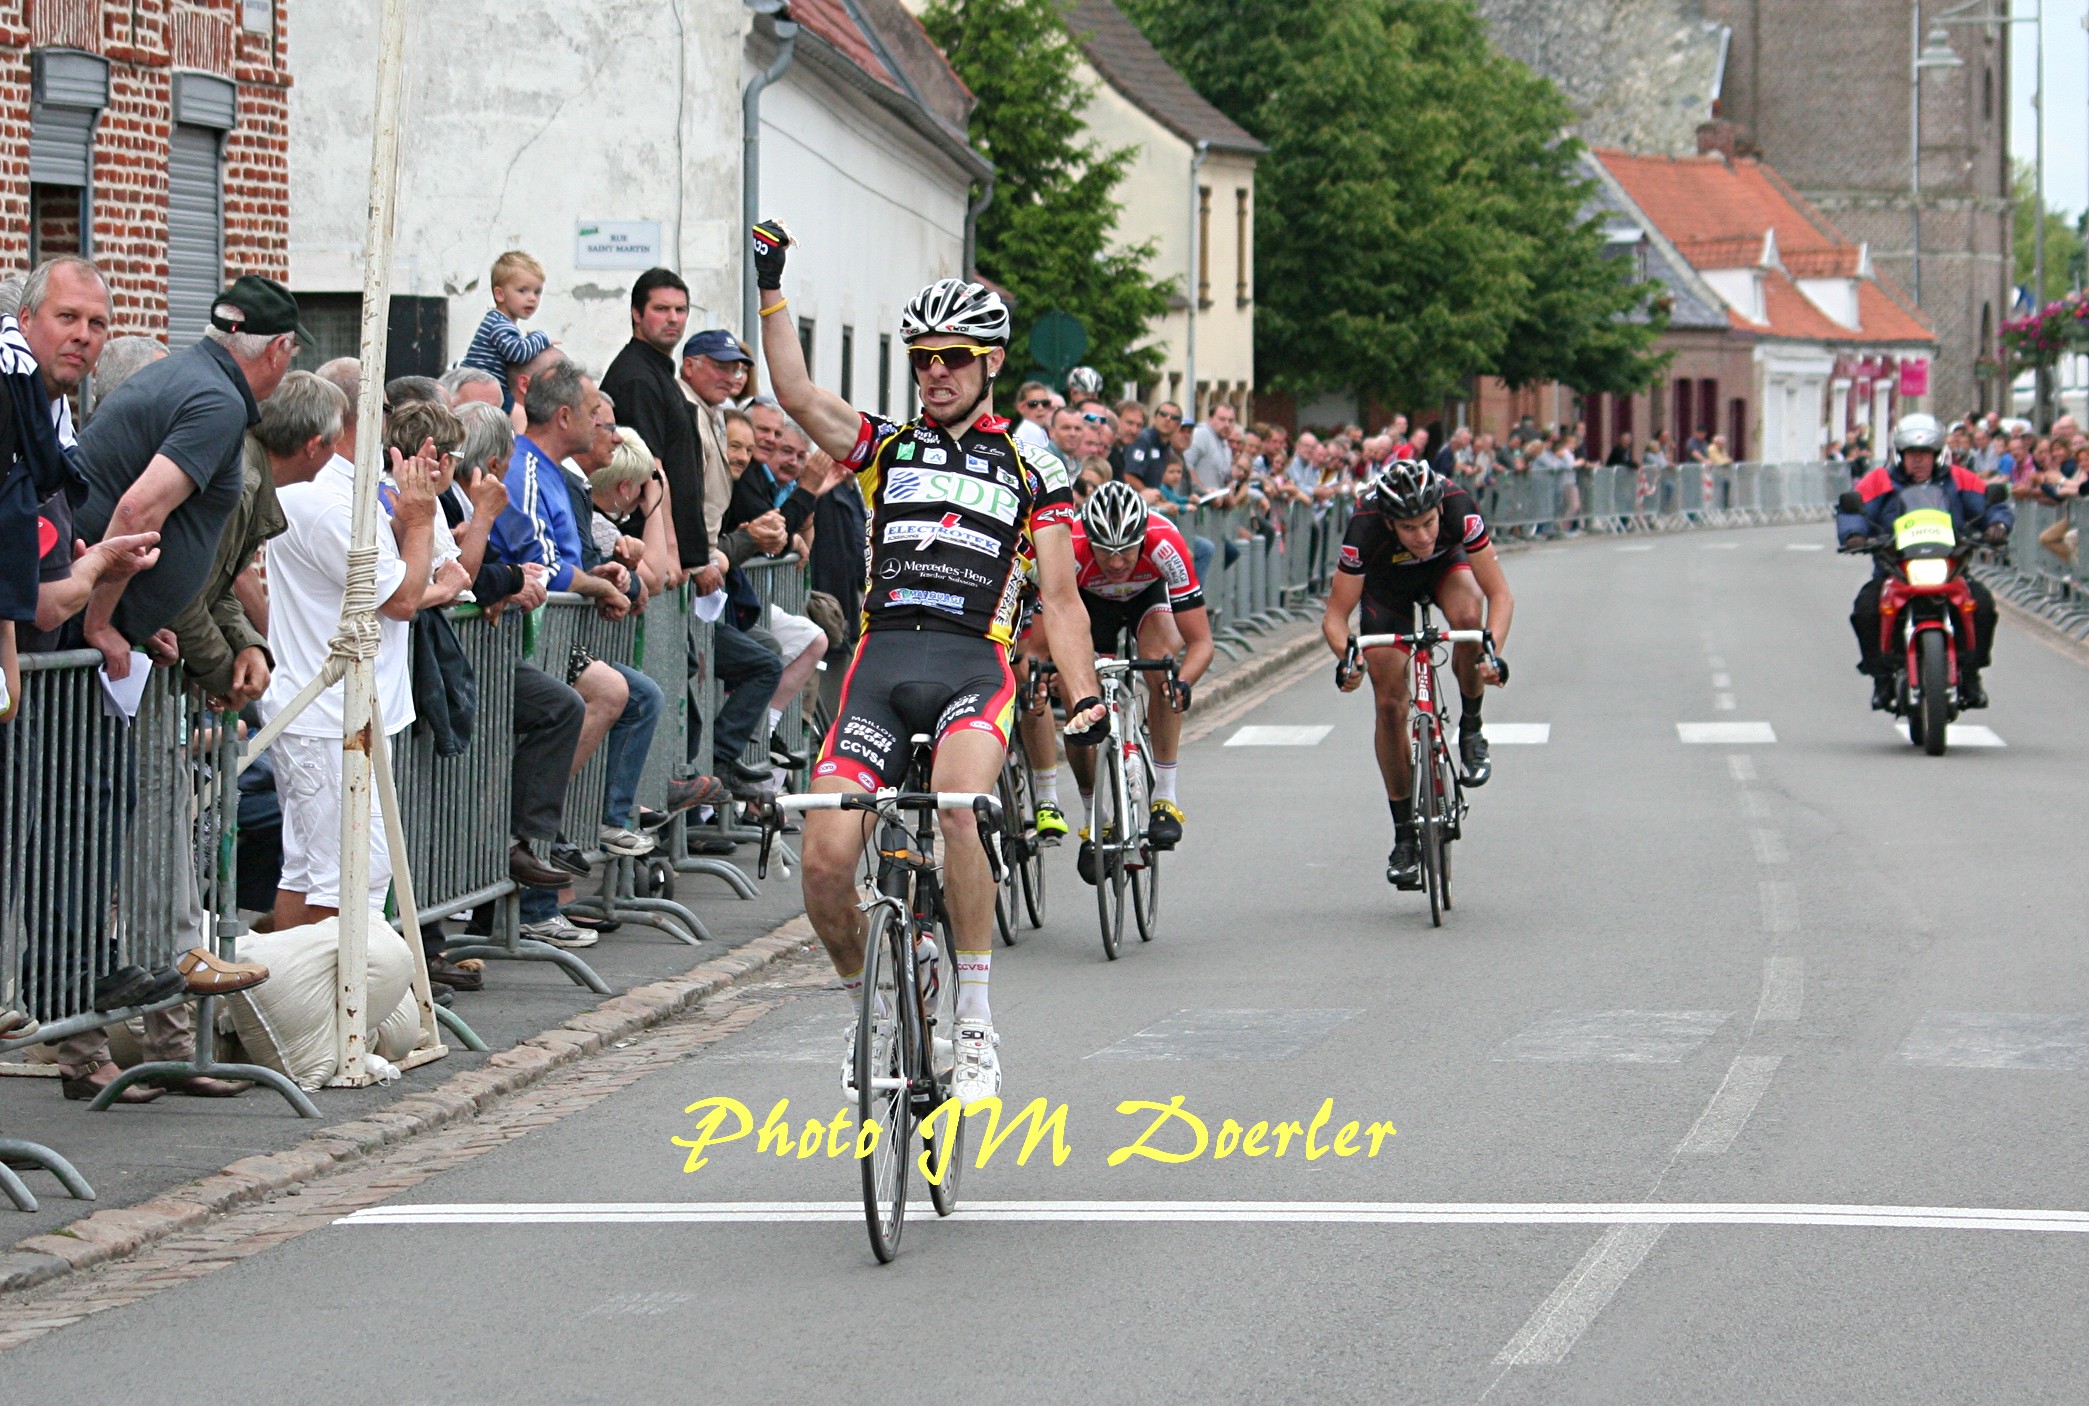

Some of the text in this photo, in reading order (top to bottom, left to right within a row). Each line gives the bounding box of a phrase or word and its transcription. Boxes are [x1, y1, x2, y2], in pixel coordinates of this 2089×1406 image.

[587, 245, 651, 253] SAINT MARTIN
[610, 234, 628, 242] RUE
[925, 473, 1018, 517] SDP
[888, 525, 998, 551] ELECTROTEK
[903, 560, 994, 587] Mercedes-Benz
[851, 715, 897, 743] MAILLOTS
[839, 739, 885, 771] CCVSA
